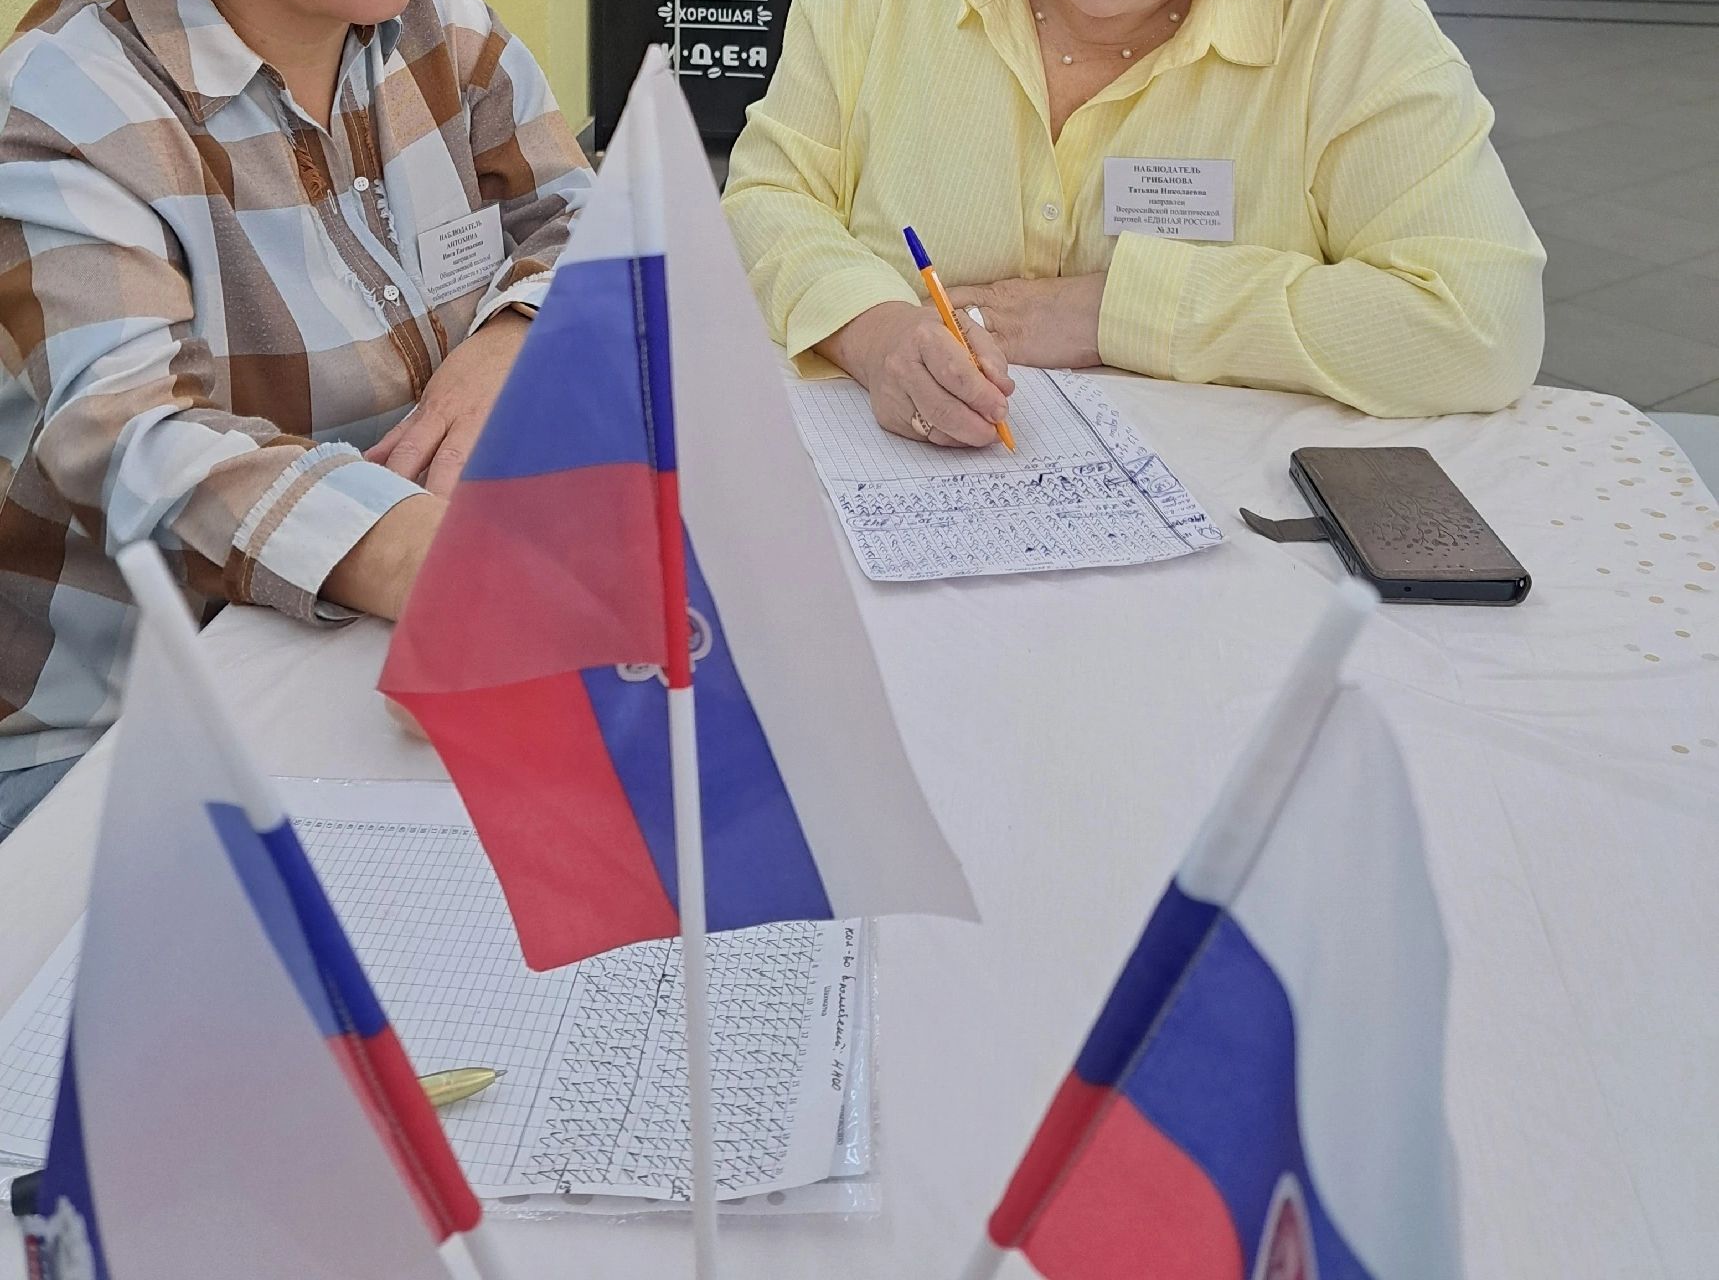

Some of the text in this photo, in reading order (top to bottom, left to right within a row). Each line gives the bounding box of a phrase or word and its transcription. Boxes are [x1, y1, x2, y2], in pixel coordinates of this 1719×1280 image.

[676, 7, 753, 23] ХОРОШАЯ
[1133, 165, 1201, 174] НАБЛЮДАТЕЛЬ
[1141, 176, 1193, 184] ГРИБАНОВА
[1128, 186, 1207, 196] Татьяна Николаевна
[1116, 205, 1220, 217] Всероссийской политической
